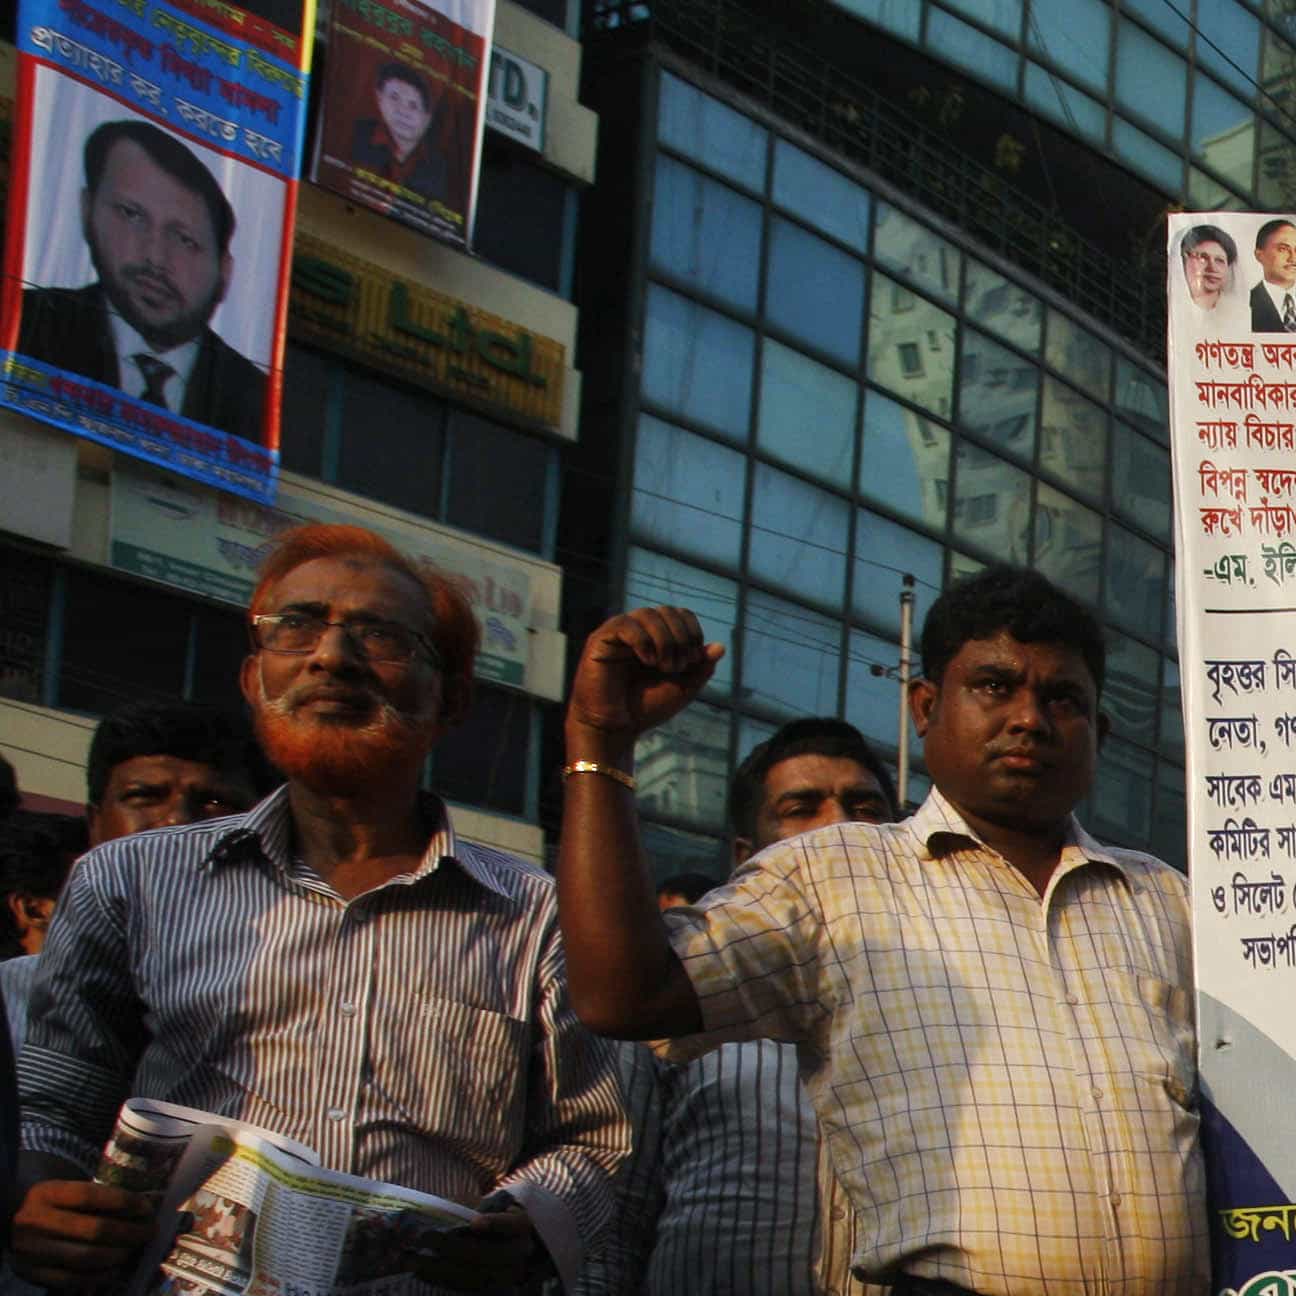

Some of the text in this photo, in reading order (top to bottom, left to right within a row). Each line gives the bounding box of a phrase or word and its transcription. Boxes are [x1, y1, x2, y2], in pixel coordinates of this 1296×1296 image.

[1195, 339, 1254, 370] গণতন্ত্র
[1196, 418, 1238, 449] ন্যায়
[1244, 414, 1294, 450] বিচার
[1198, 460, 1248, 500] বিপন্ন
[1200, 504, 1243, 537] রুখে
[1205, 660, 1265, 705] বৃহত্তর
[1207, 712, 1267, 753] নেতা,
[1205, 772, 1262, 808] সাবেক
[1207, 818, 1271, 859] কমিটির
[1211, 886, 1227, 914] ও
[1232, 872, 1284, 914] সিলেট
